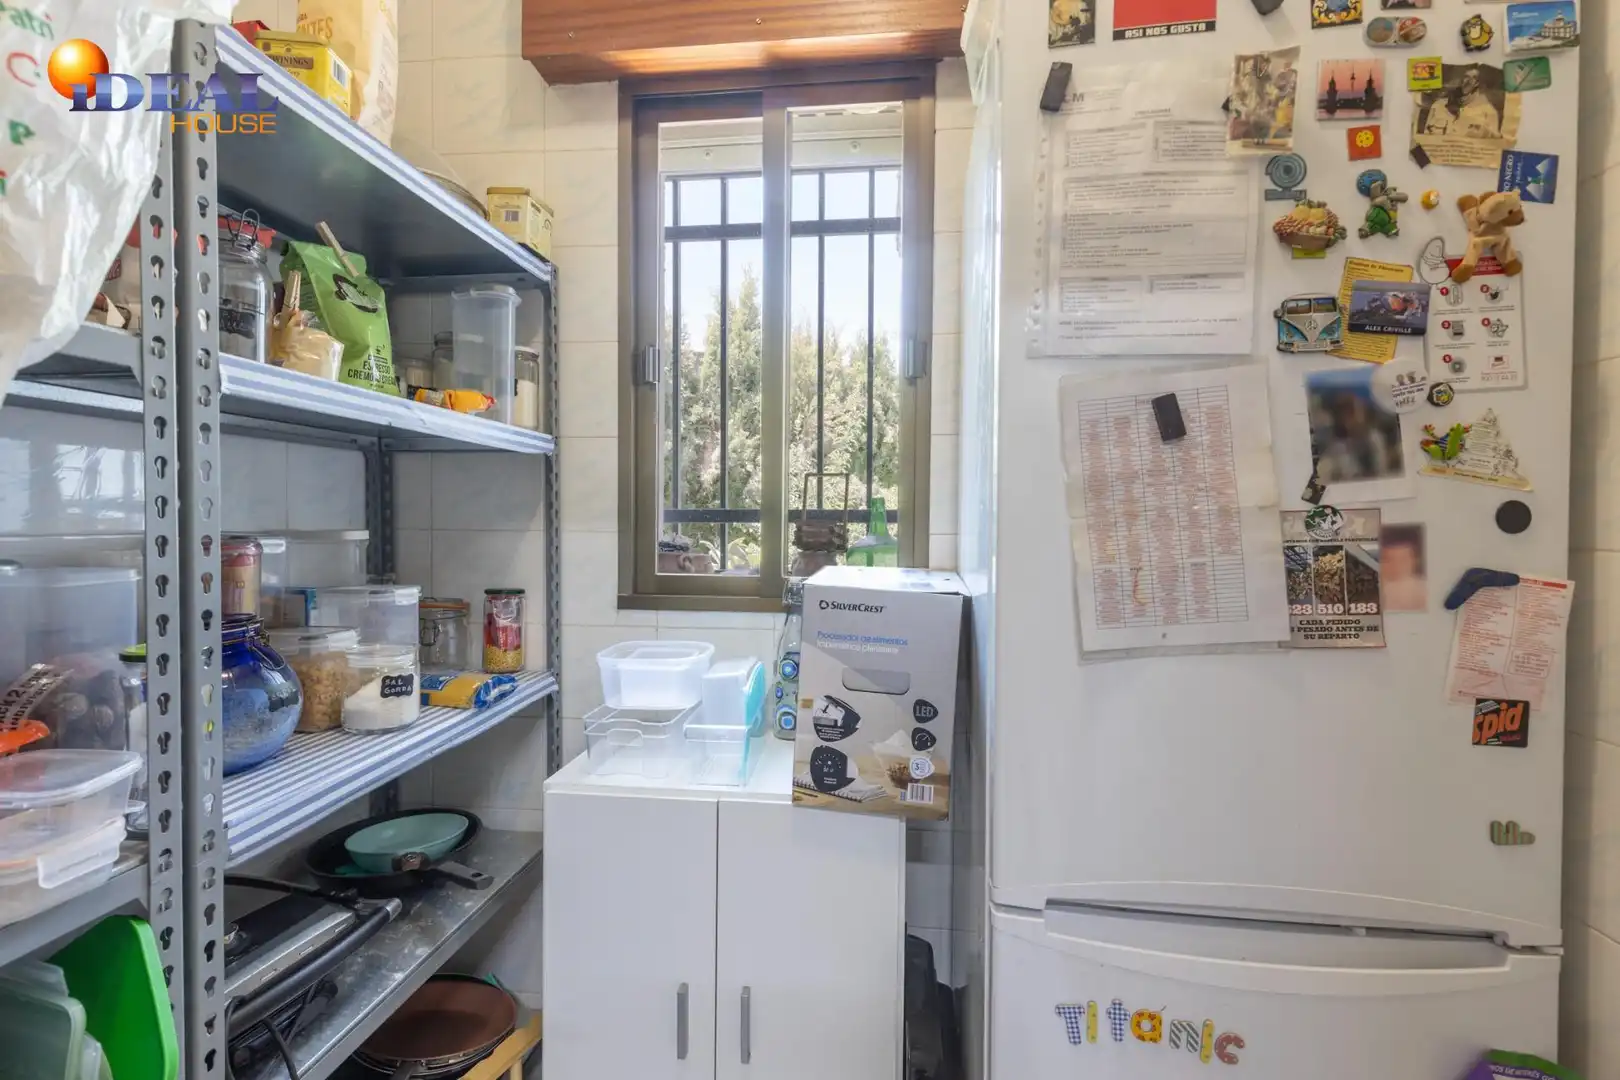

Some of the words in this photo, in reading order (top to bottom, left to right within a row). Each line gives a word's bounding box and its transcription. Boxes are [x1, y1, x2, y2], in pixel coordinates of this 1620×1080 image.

[1145, 26, 1168, 37] NOS
[1170, 22, 1206, 34] GUSTA
[266, 54, 309, 66] WININGS
[1317, 603, 1345, 614] 510
[1348, 602, 1378, 614] 183
[1335, 625, 1364, 633] ANTES
[1366, 624, 1379, 632] DE
[1317, 632, 1360, 640] REPARTO
[385, 678, 403, 686] SAL
[915, 705, 933, 718] LED
